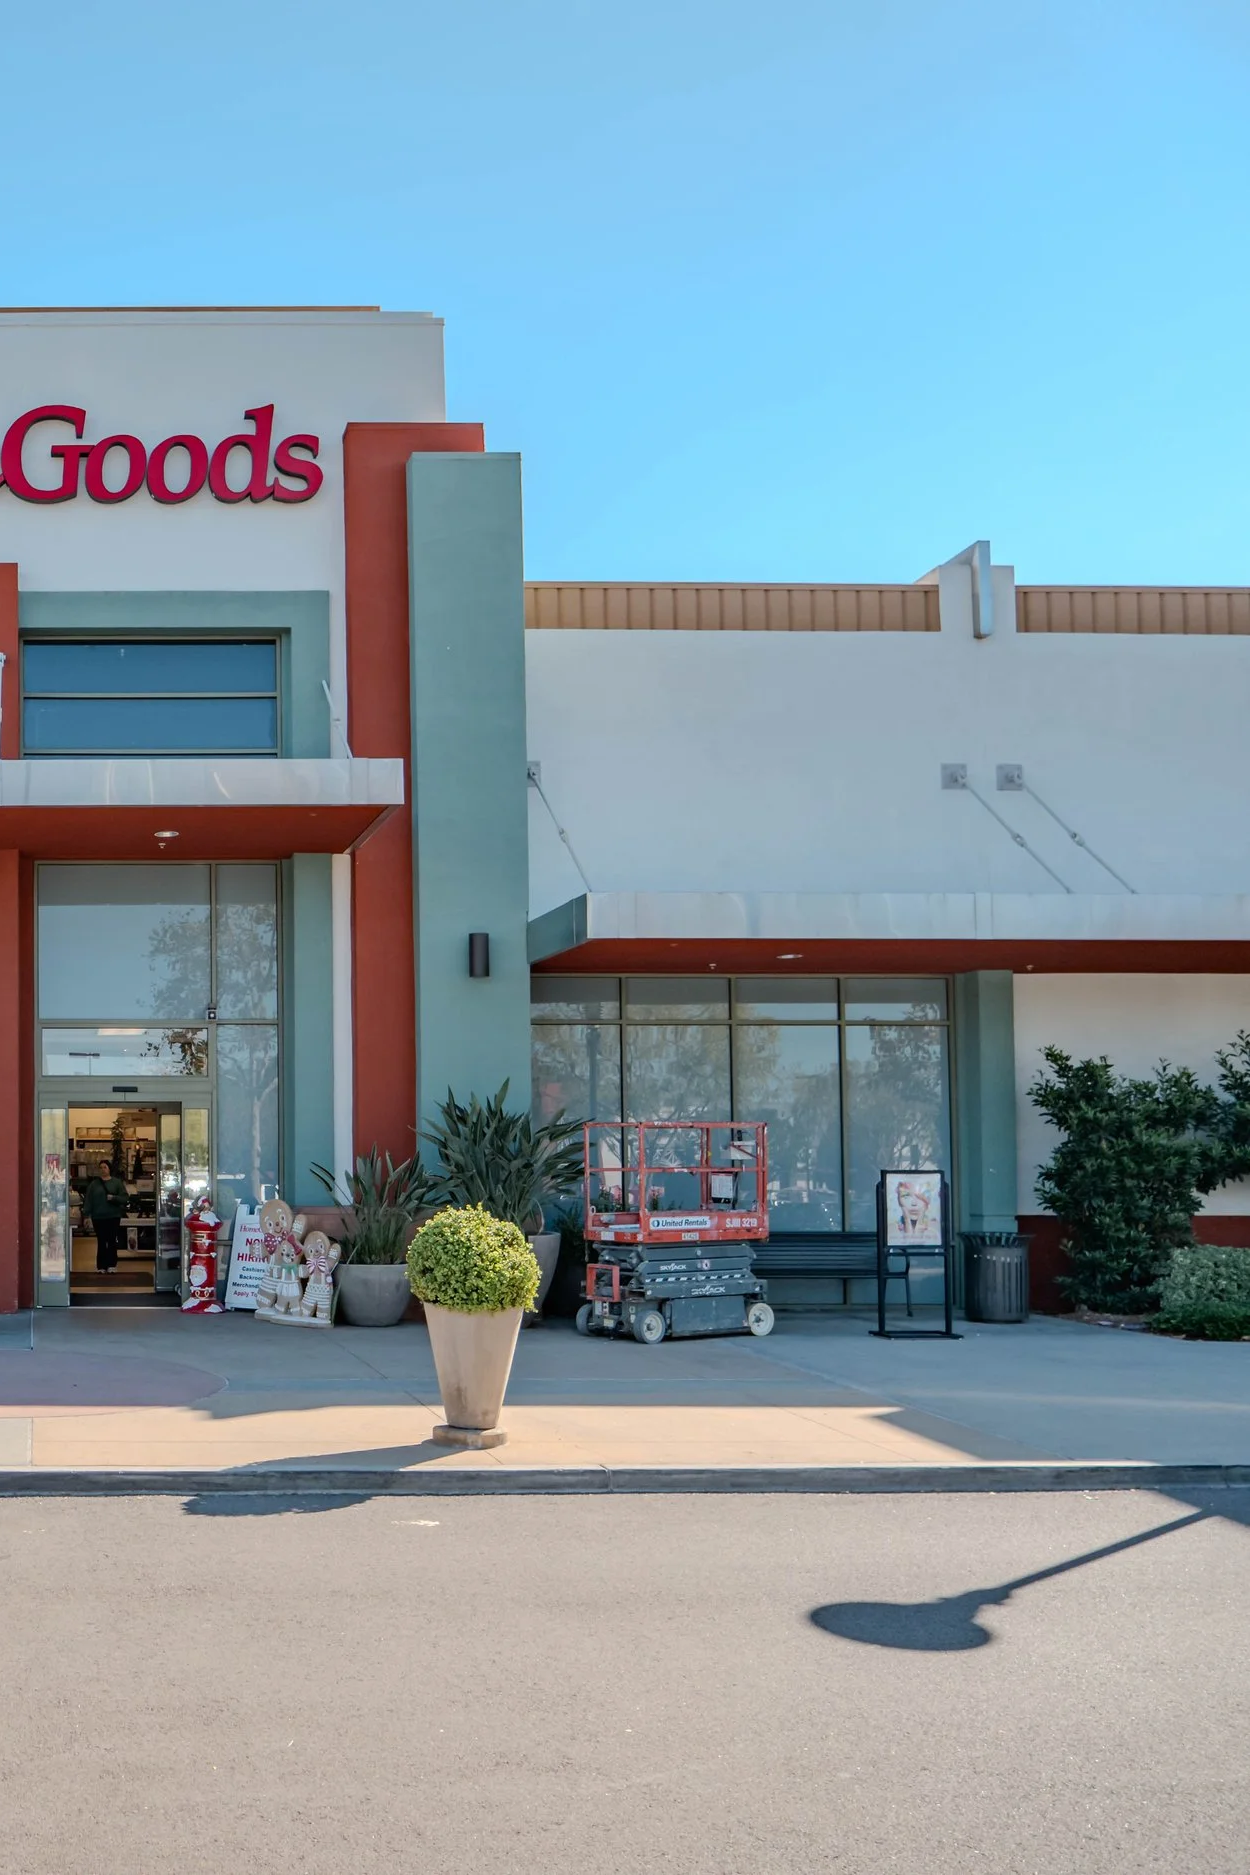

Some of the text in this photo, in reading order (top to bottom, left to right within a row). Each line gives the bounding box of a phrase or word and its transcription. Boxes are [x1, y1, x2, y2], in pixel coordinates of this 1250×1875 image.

[661, 1219, 683, 1227] United
[660, 1263, 687, 1271] SKYJACK
[233, 1290, 249, 1298] Apply
